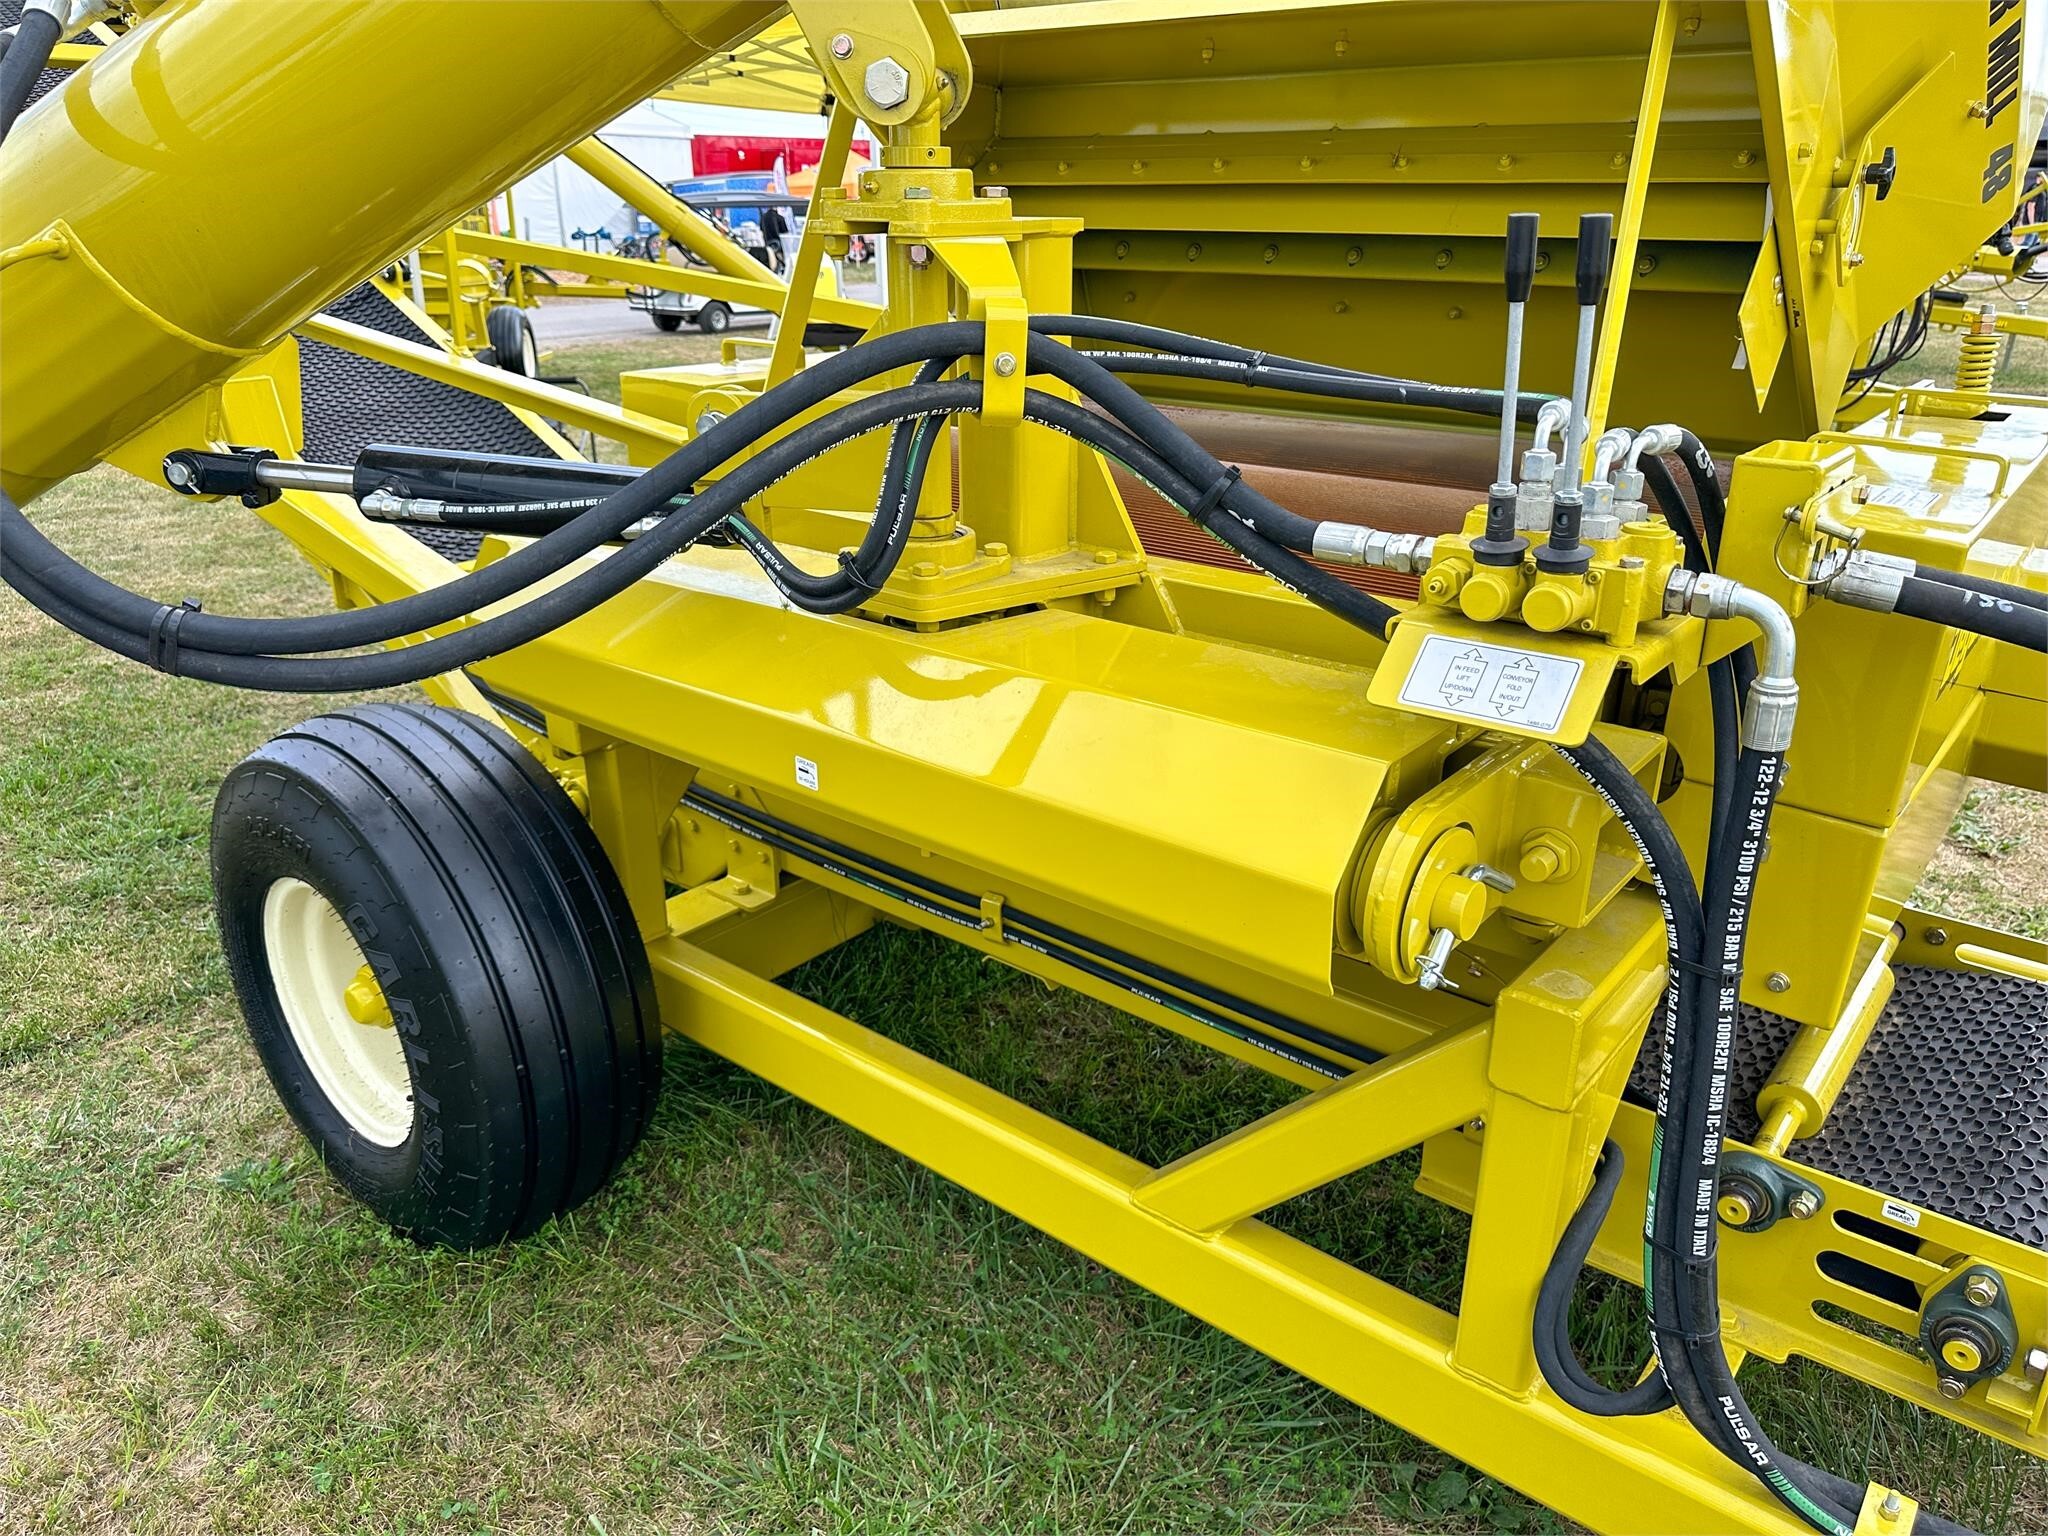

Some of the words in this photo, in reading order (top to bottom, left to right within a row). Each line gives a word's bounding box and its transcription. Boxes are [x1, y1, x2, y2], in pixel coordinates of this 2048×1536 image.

[1985, 17, 2021, 129] MILL
[1982, 143, 2013, 204] 48
[1218, 360, 1239, 368] MADE
[887, 494, 908, 546] PULSAR
[755, 542, 784, 572] PULSAR
[1454, 664, 1462, 672] IN
[1462, 666, 1480, 674] FEED
[1456, 674, 1471, 682] LIFT
[1502, 673, 1534, 684] CONVEYOR
[1444, 683, 1474, 693] UP/DOWN
[1498, 694, 1521, 702] IN/OUT
[1506, 684, 1522, 692] FOLD
[1752, 757, 1777, 805] 122-12
[1747, 809, 1766, 837] 3/4"
[1738, 840, 1759, 873] 3100
[1732, 876, 1751, 896] PSI
[1652, 873, 1667, 897] SAE
[1660, 899, 1674, 920] WP
[1668, 924, 1679, 949] BAR
[1727, 907, 1745, 932] 215
[1723, 934, 1741, 960] BAR
[1668, 988, 1680, 1011] PSI
[1718, 988, 1735, 1012] SAE
[1664, 1012, 1678, 1045] 3100
[1713, 1015, 1733, 1072] 100R2AT
[1661, 1045, 1674, 1072] 3/4"
[1656, 1072, 1671, 1117] 122-12
[1707, 1074, 1726, 1111] MSHA
[1702, 1114, 1722, 1166] IC-188/4
[1696, 1179, 1713, 1216] MADE
[1695, 1217, 1710, 1228] IN
[1886, 1209, 1911, 1222] GREASE
[1692, 1229, 1708, 1257] ITALY
[1718, 1394, 1769, 1467] PULSAR
